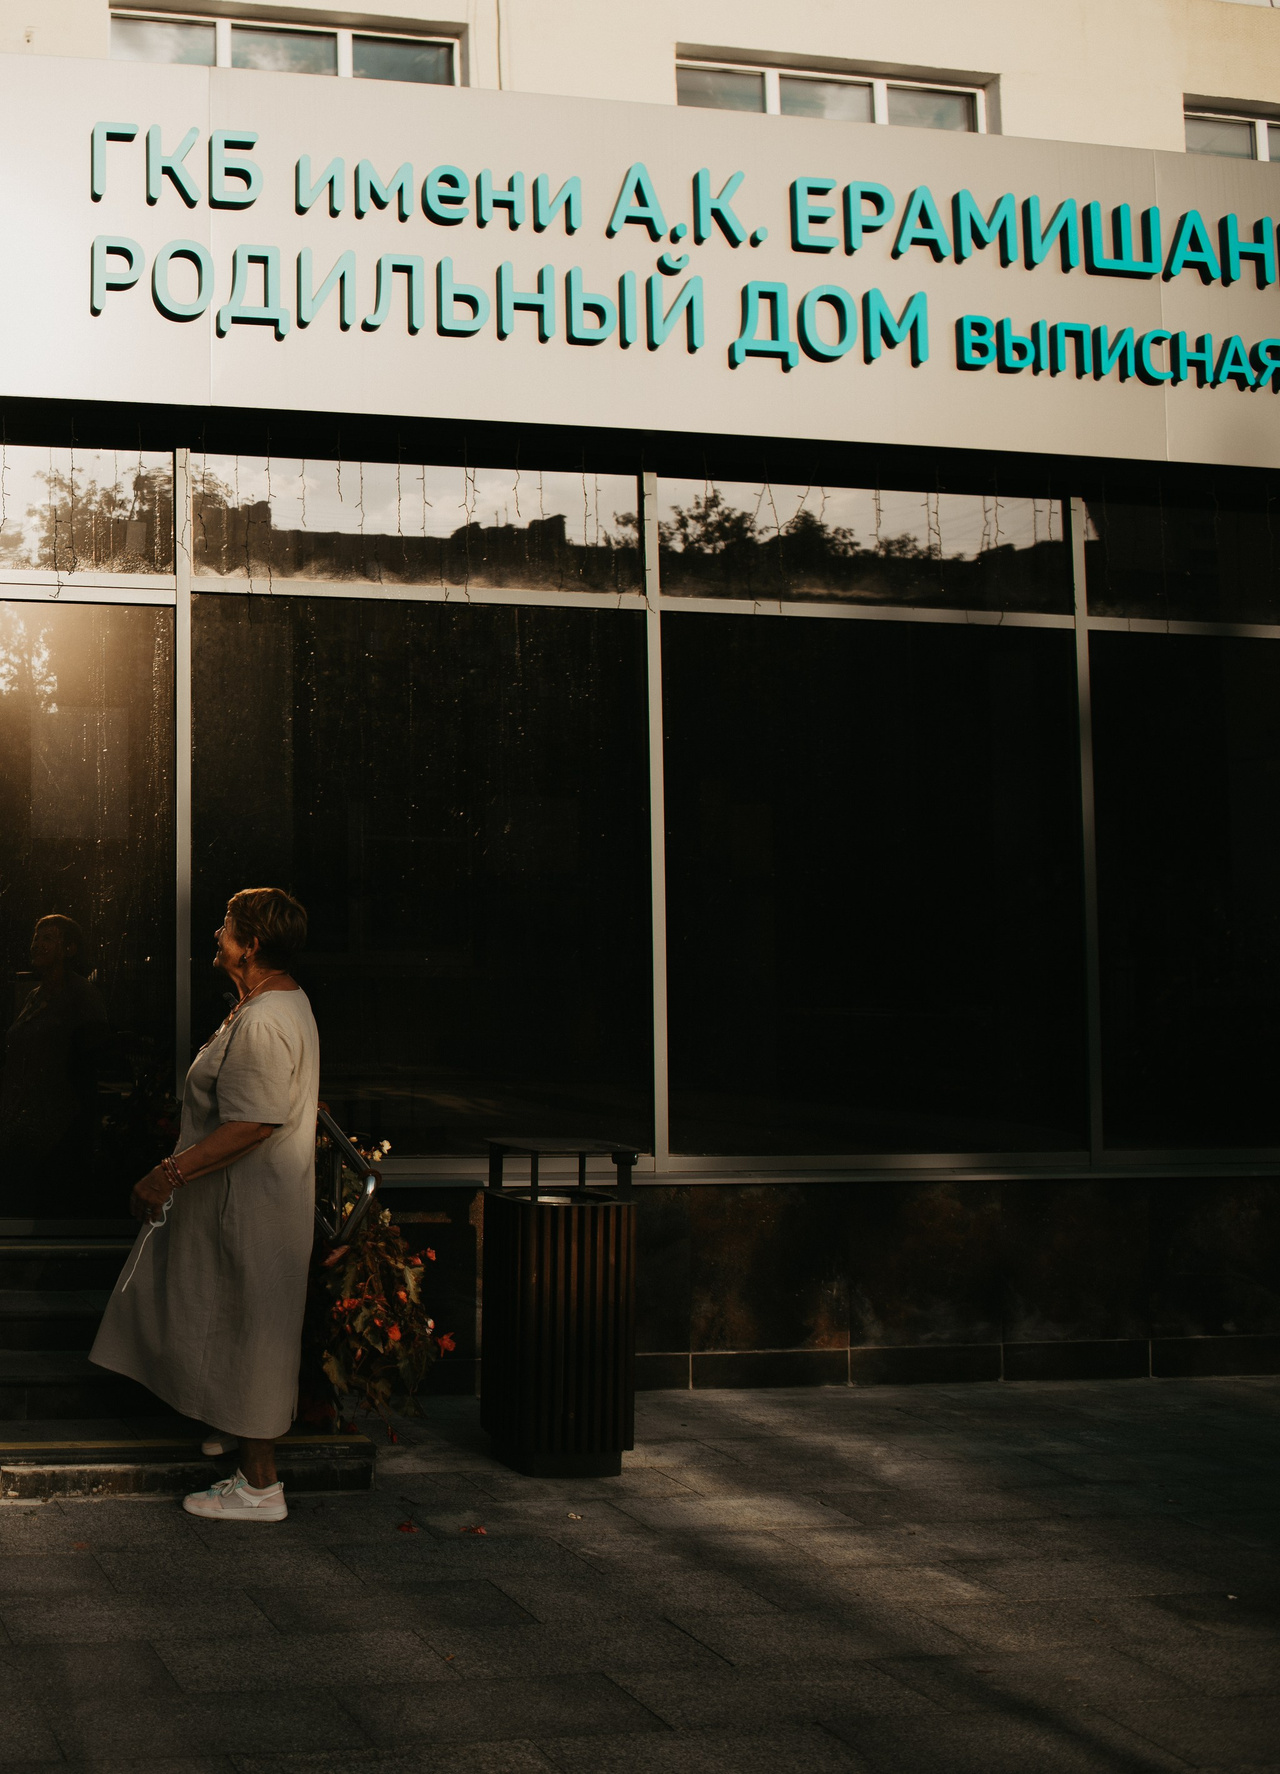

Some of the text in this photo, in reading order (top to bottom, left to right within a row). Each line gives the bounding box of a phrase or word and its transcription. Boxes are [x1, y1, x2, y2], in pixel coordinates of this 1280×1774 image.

[90, 121, 1280, 291] ГКБ имени А.К. ЕРАМИШАН
[90, 235, 705, 354] РОДИЛЬНЫЙ
[728, 281, 930, 373] ДОМ
